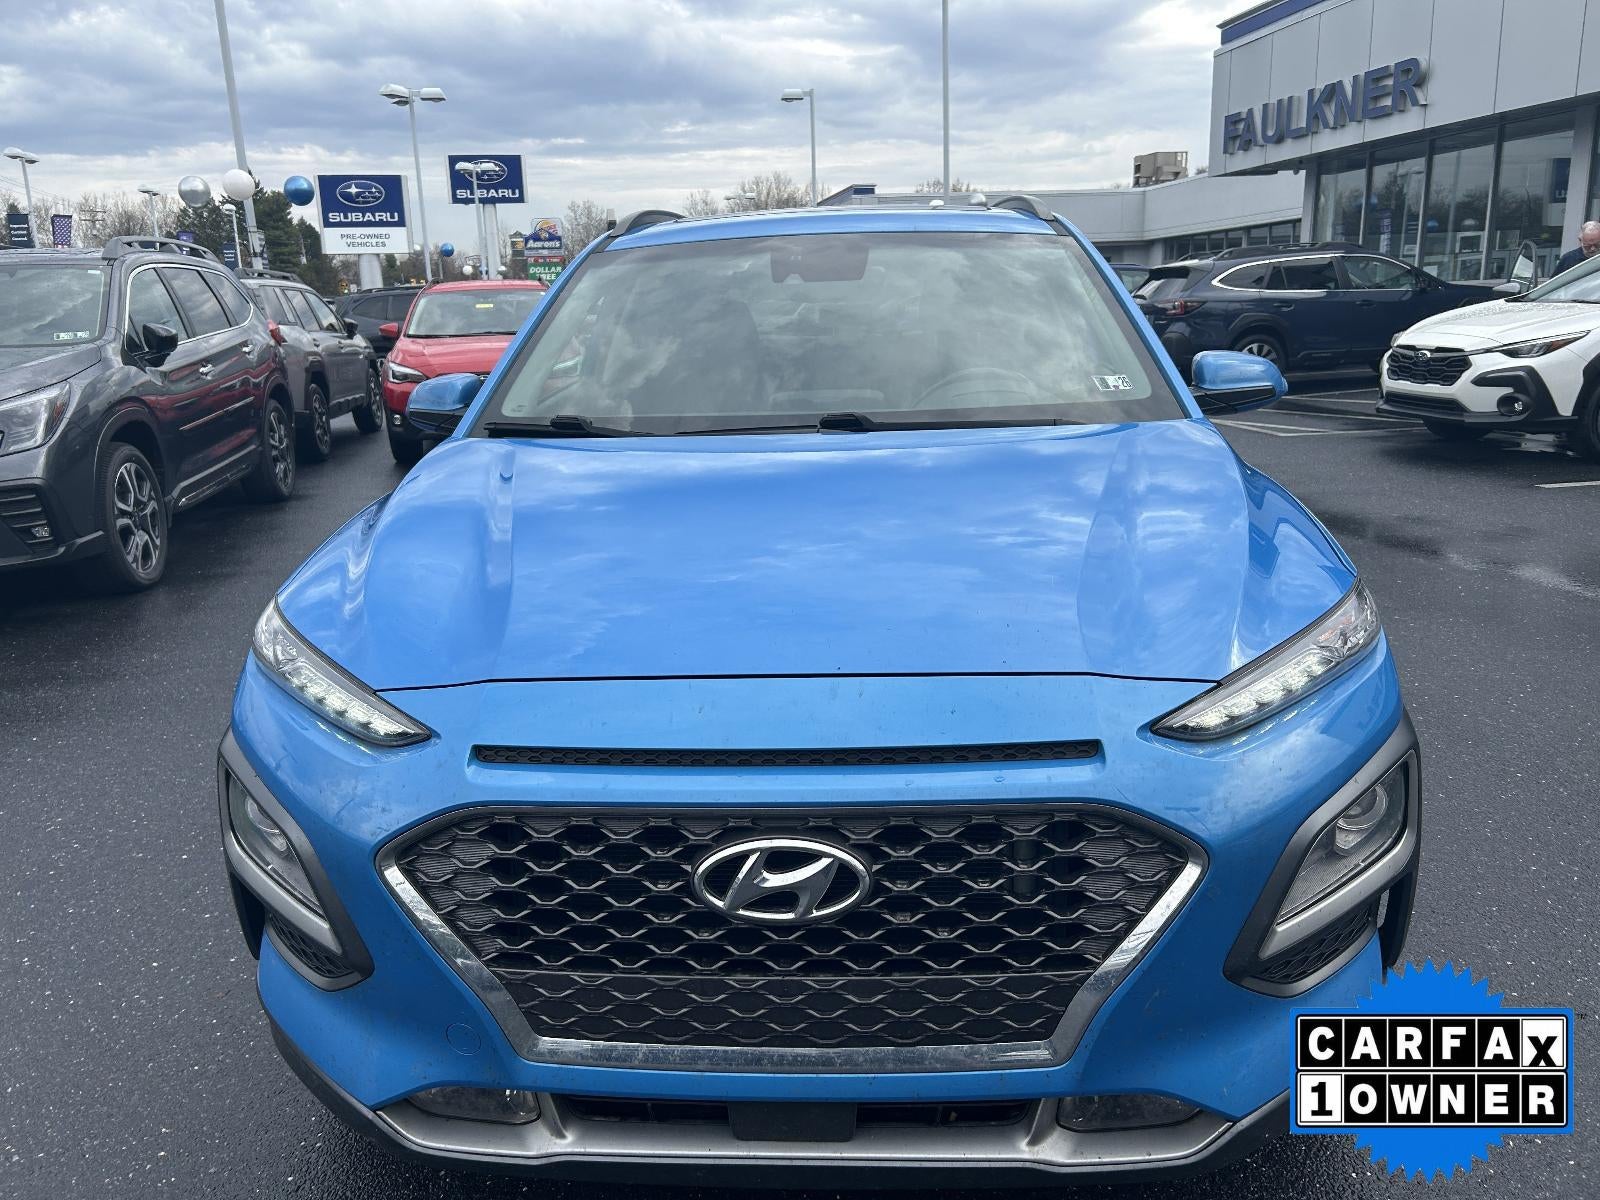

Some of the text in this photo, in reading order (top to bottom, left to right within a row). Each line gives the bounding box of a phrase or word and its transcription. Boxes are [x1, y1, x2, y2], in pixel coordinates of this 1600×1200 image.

[1223, 58, 1427, 154] FAULKNER
[456, 188, 519, 199] SUBARU
[328, 212, 399, 223] SUBARU
